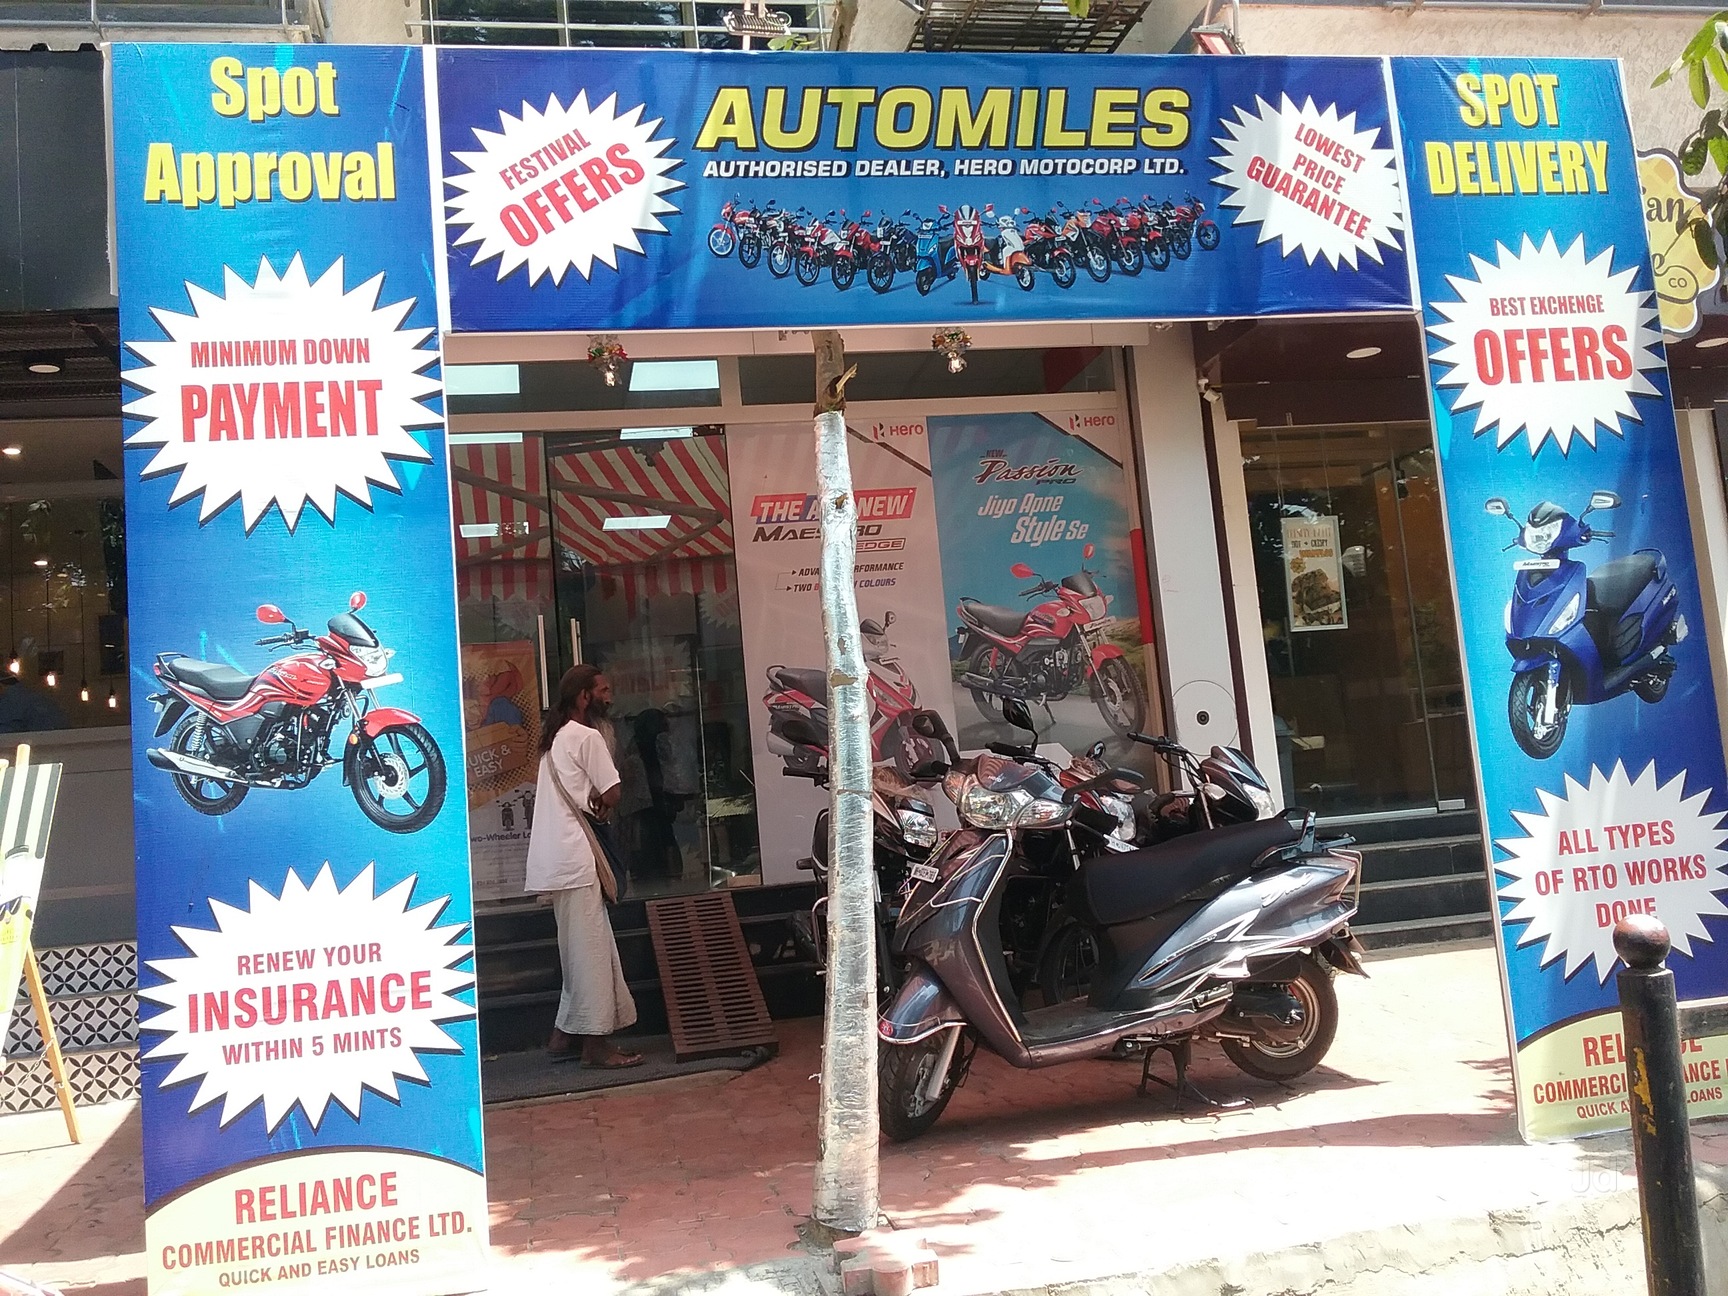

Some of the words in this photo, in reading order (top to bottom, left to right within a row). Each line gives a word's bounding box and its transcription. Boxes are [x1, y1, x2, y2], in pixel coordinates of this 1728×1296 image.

[210, 56, 340, 123] Spot
[1456, 73, 1560, 128] SPOT
[693, 86, 1192, 151] AUTOMILES
[499, 129, 591, 190] FESTIVAL
[1295, 123, 1366, 174] LOWEST
[144, 141, 397, 209] Approval
[703, 159, 848, 179] AUTHORISED
[855, 159, 946, 178] DEALER,
[954, 158, 1013, 176] HERO
[1019, 158, 1137, 175] MOTOCORP
[1143, 158, 1185, 175] LTD.
[1293, 153, 1347, 195] PRICE
[1425, 141, 1609, 195] DELIVERY
[499, 143, 646, 247] OFFERS
[1246, 155, 1371, 241] GUARANTEE
[1490, 296, 1527, 316] BEST
[1530, 294, 1605, 315] EXCHENGE
[191, 339, 297, 368] MINIMUM
[303, 338, 370, 365] DOWN
[1473, 325, 1633, 386] OFFERS
[181, 379, 383, 443] PAYMENT
[973, 459, 1083, 485] Passion
[1036, 478, 1078, 486] PRO
[760, 500, 803, 523] THE
[856, 495, 909, 517] NEW
[977, 494, 1018, 519] Jiyo
[1018, 493, 1064, 514] Apne
[1010, 514, 1067, 547] Style
[1066, 520, 1090, 540] Se
[794, 583, 812, 593] TWO
[859, 578, 897, 588] COLOURS
[854, 562, 905, 573] RFORMANCE
[466, 748, 499, 768] UICK
[501, 744, 511, 756] &
[474, 758, 503, 778] EASY
[1558, 829, 1598, 856] ALL
[1604, 820, 1675, 852] TYPES
[1535, 869, 1564, 897] OF
[1574, 864, 1619, 893] RTO
[1624, 854, 1708, 887] WORKS
[237, 948, 316, 975] RENEW
[323, 942, 382, 967] YOUR
[188, 970, 433, 1034] INSURANCE
[222, 1037, 303, 1065] WITHIN
[312, 1035, 324, 1056] 5
[333, 1027, 402, 1054] MINTS
[1533, 1073, 1627, 1104] COMMERCI
[1577, 1104, 1618, 1119] QUICK
[1687, 1086, 1723, 1104] OANS
[235, 1171, 398, 1225] RELIANCE
[162, 1230, 317, 1270] COMMERCIAL
[325, 1216, 420, 1249] FINANCE
[429, 1210, 473, 1238] LTD.
[218, 1267, 272, 1287] QUICK
[277, 1262, 311, 1281] AND
[317, 1256, 360, 1275] EASY
[365, 1249, 420, 1269] LOANS
